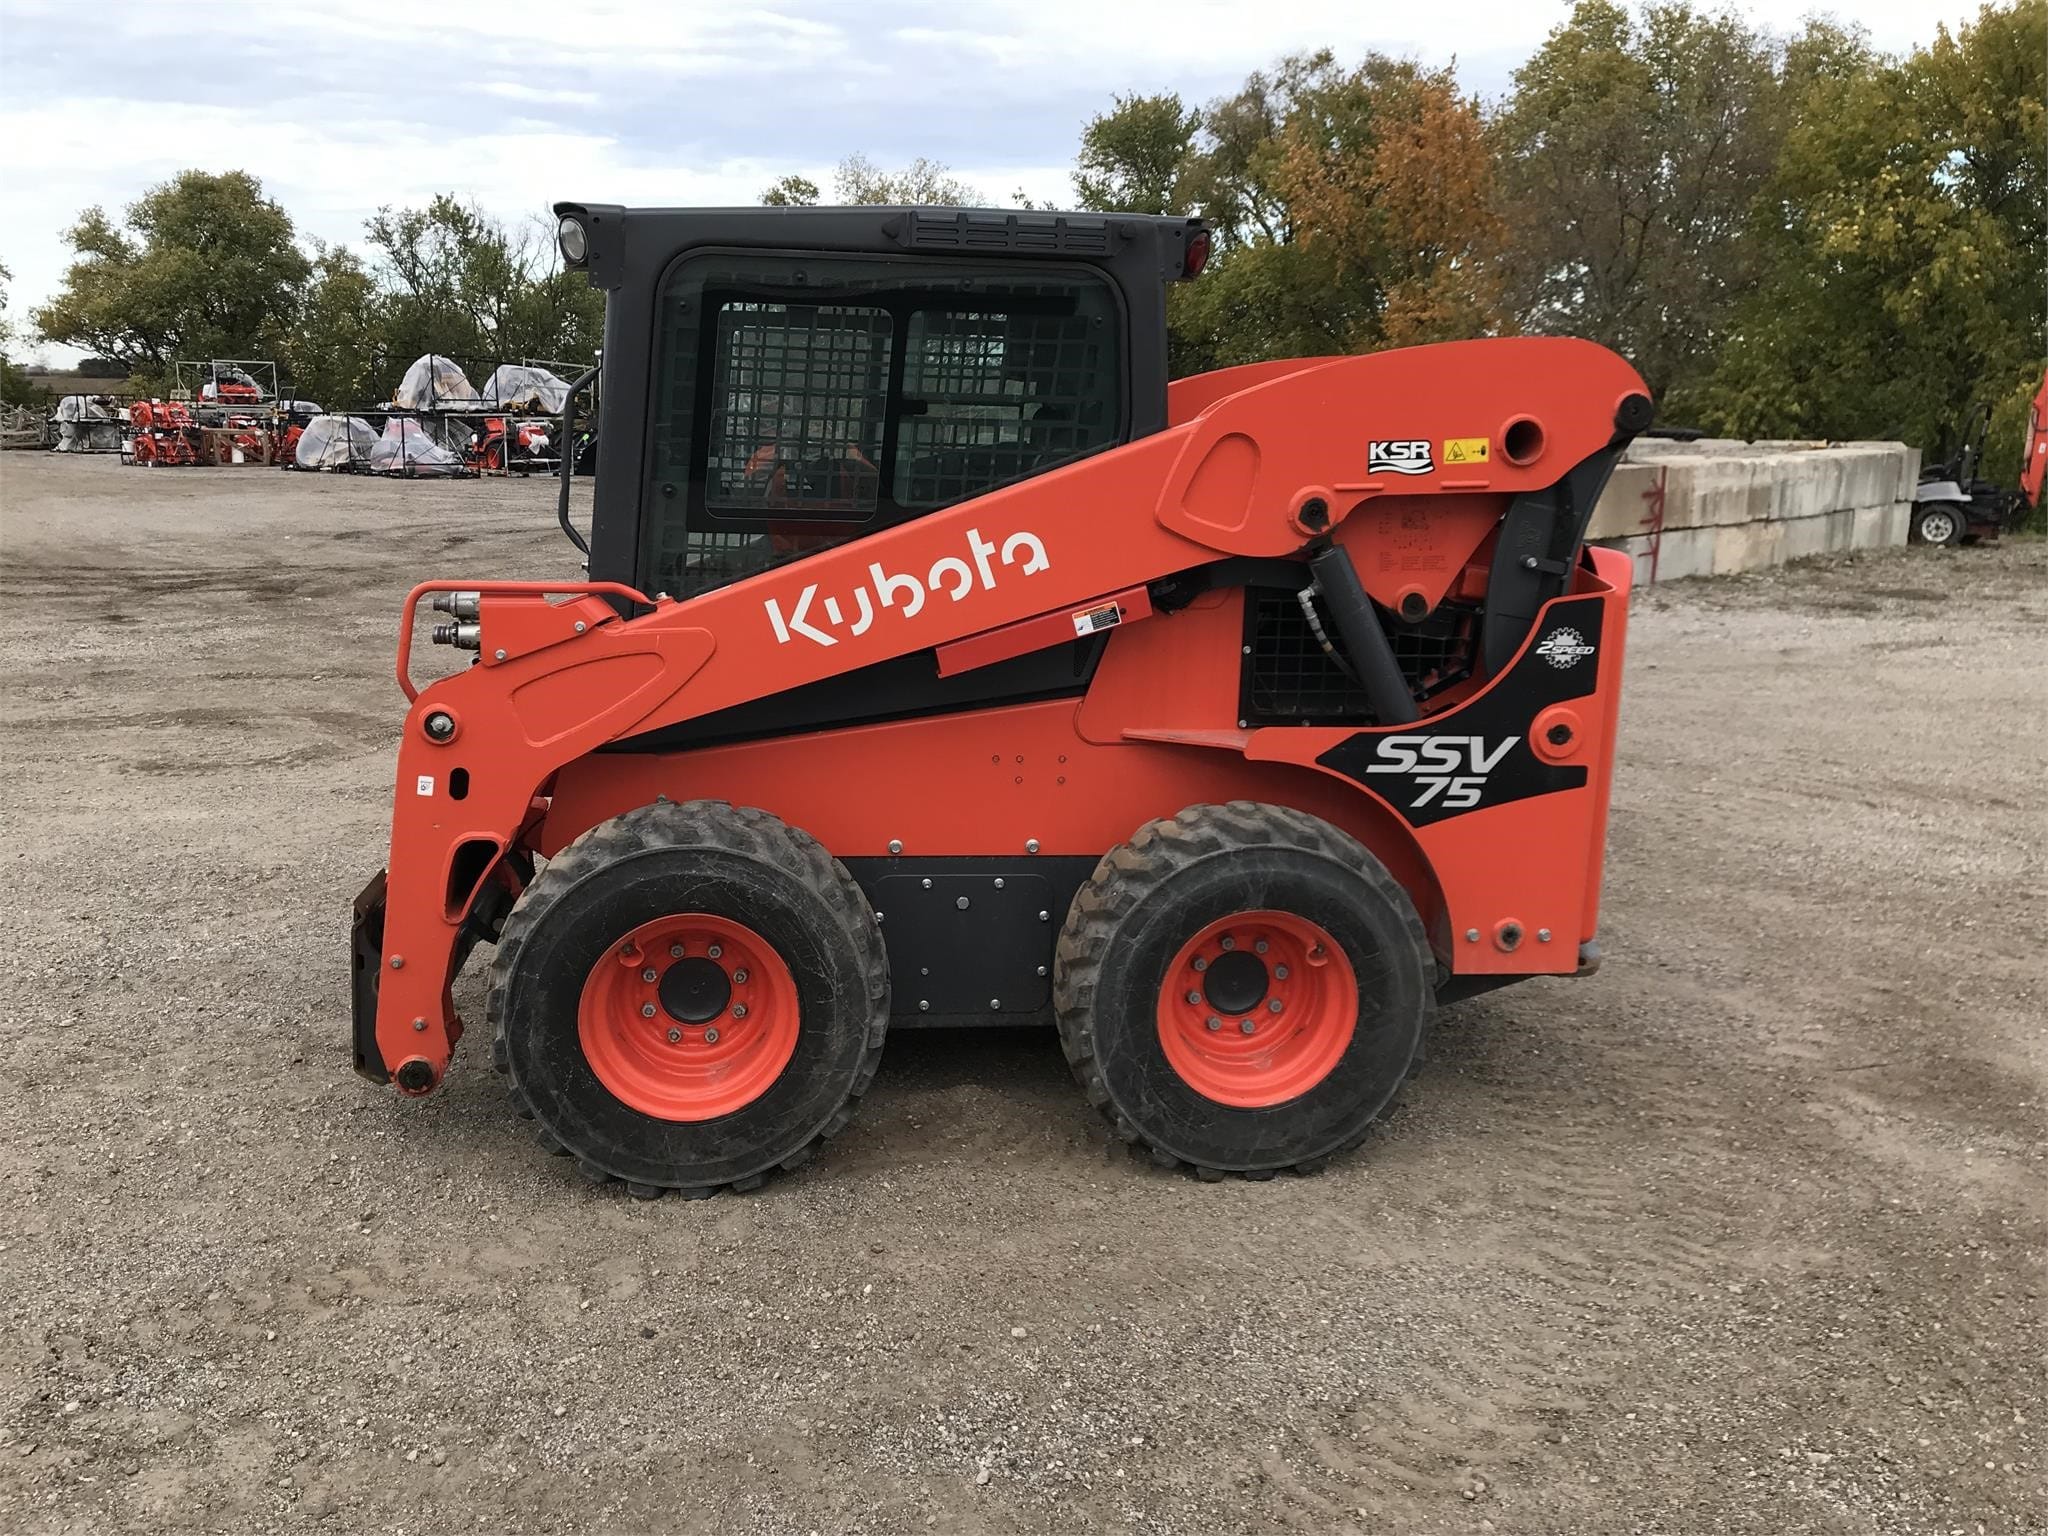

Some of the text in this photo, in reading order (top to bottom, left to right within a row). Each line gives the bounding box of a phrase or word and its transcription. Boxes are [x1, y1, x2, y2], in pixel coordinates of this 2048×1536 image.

[1369, 441, 1431, 460] KSR
[764, 528, 1050, 647] Kubota
[1366, 736, 1521, 773] SSV
[1410, 777, 1487, 807] 75
